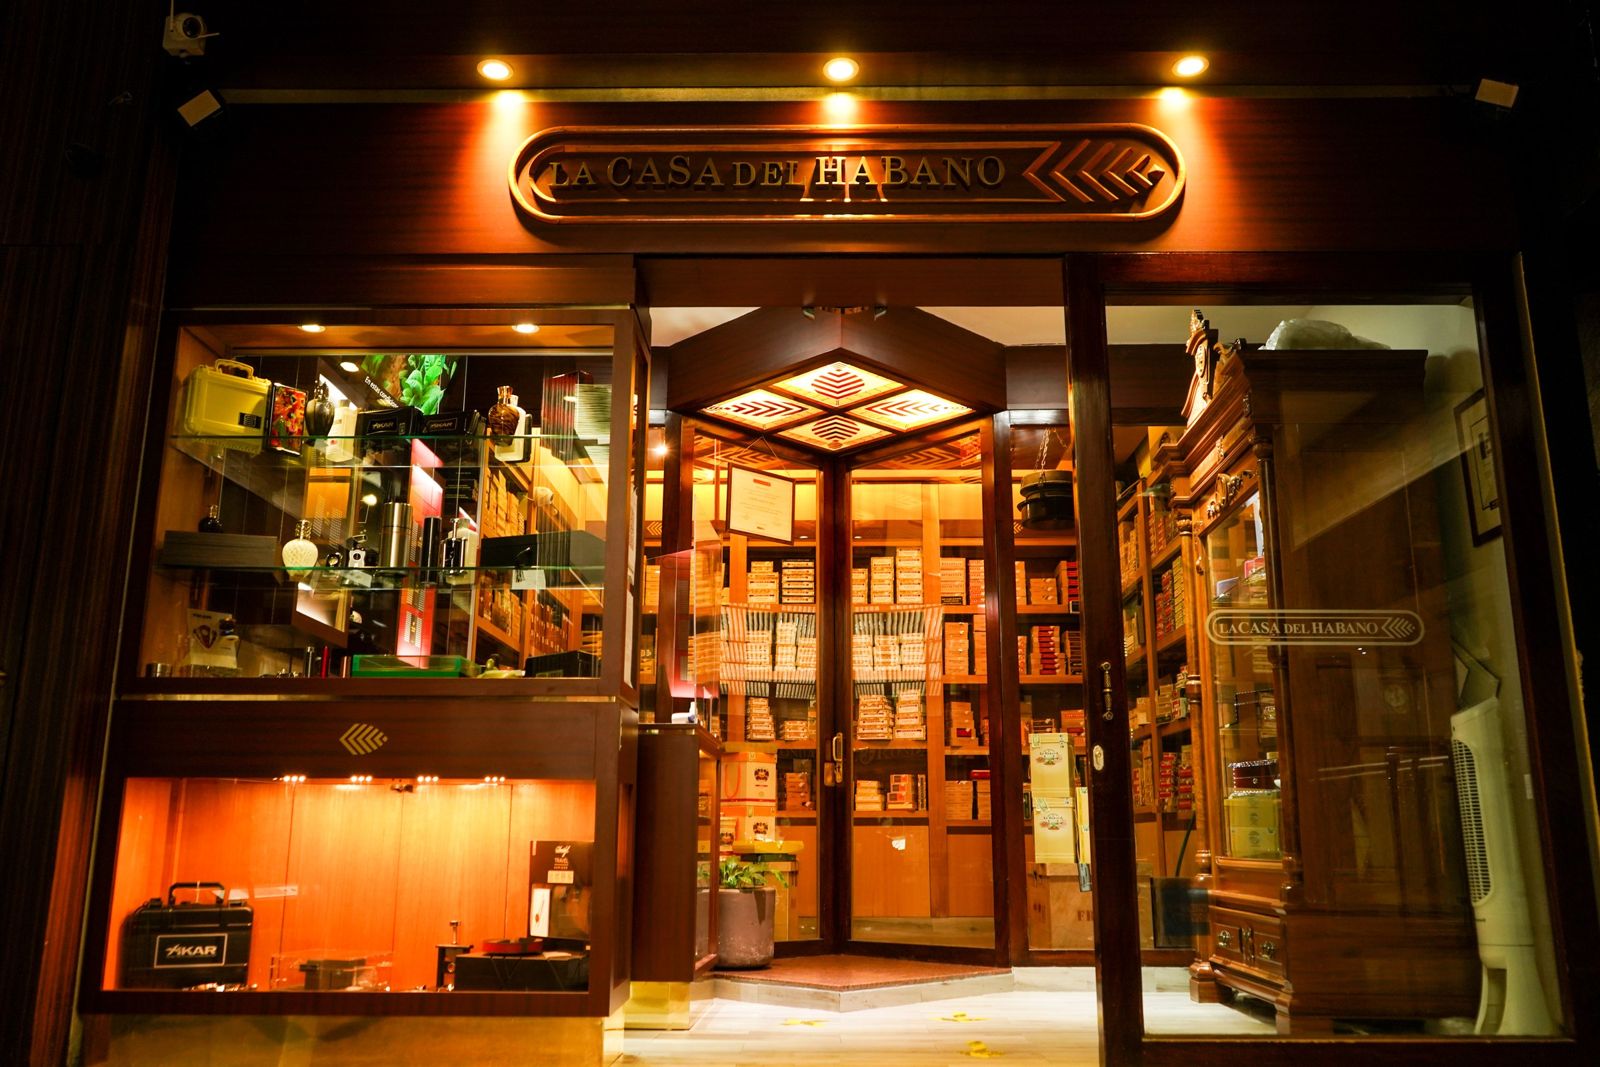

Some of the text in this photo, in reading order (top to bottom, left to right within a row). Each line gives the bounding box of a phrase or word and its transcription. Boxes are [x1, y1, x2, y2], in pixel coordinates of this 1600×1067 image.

[548, 155, 1006, 187] LA CASA DEL HABANO
[1219, 621, 1379, 635] LA CASA DEL HABANO
